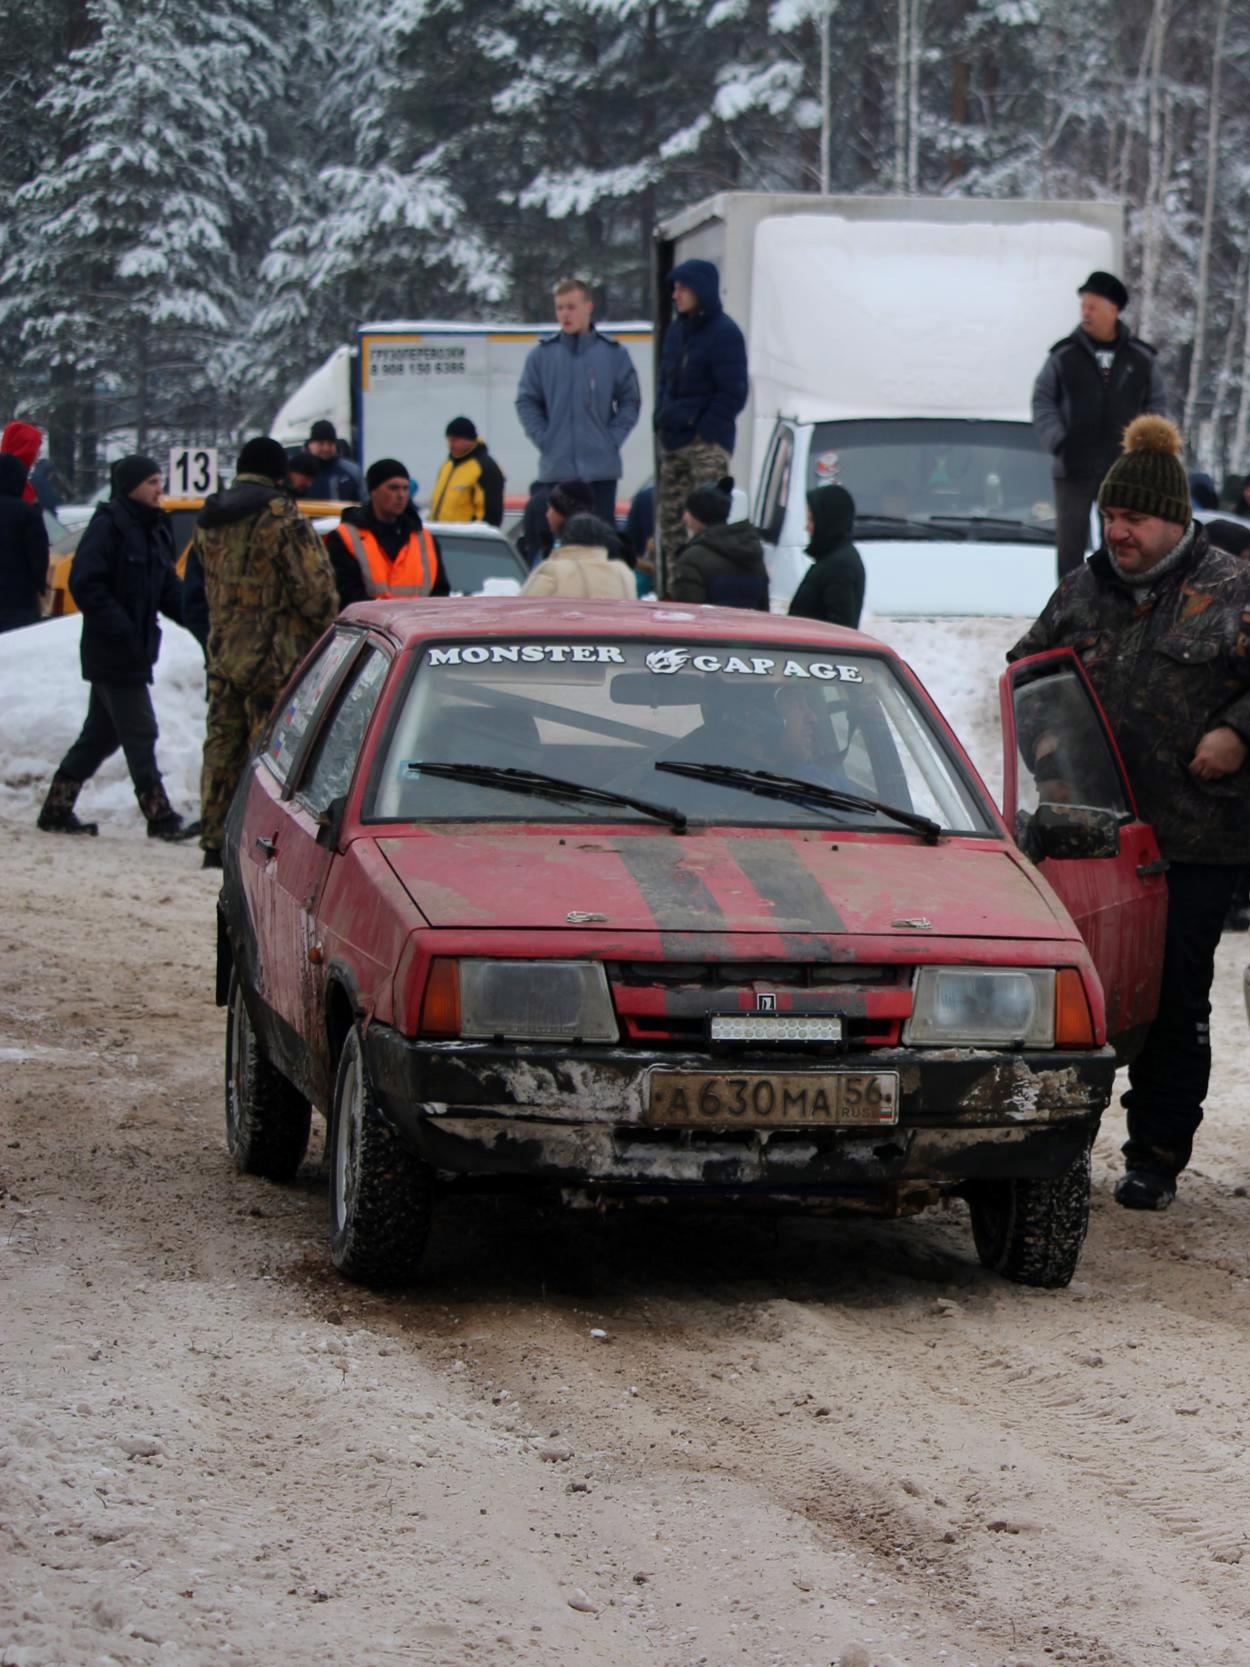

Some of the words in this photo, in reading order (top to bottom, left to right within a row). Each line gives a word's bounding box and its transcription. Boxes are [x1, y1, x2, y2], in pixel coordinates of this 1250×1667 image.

[370, 347, 465, 361] ГРУЗОПЕРЕВОЗКИ
[176, 451, 210, 492] 13
[428, 646, 625, 666] MONSTER
[844, 1076, 881, 1105] 56
[842, 1107, 871, 1119] RUS
